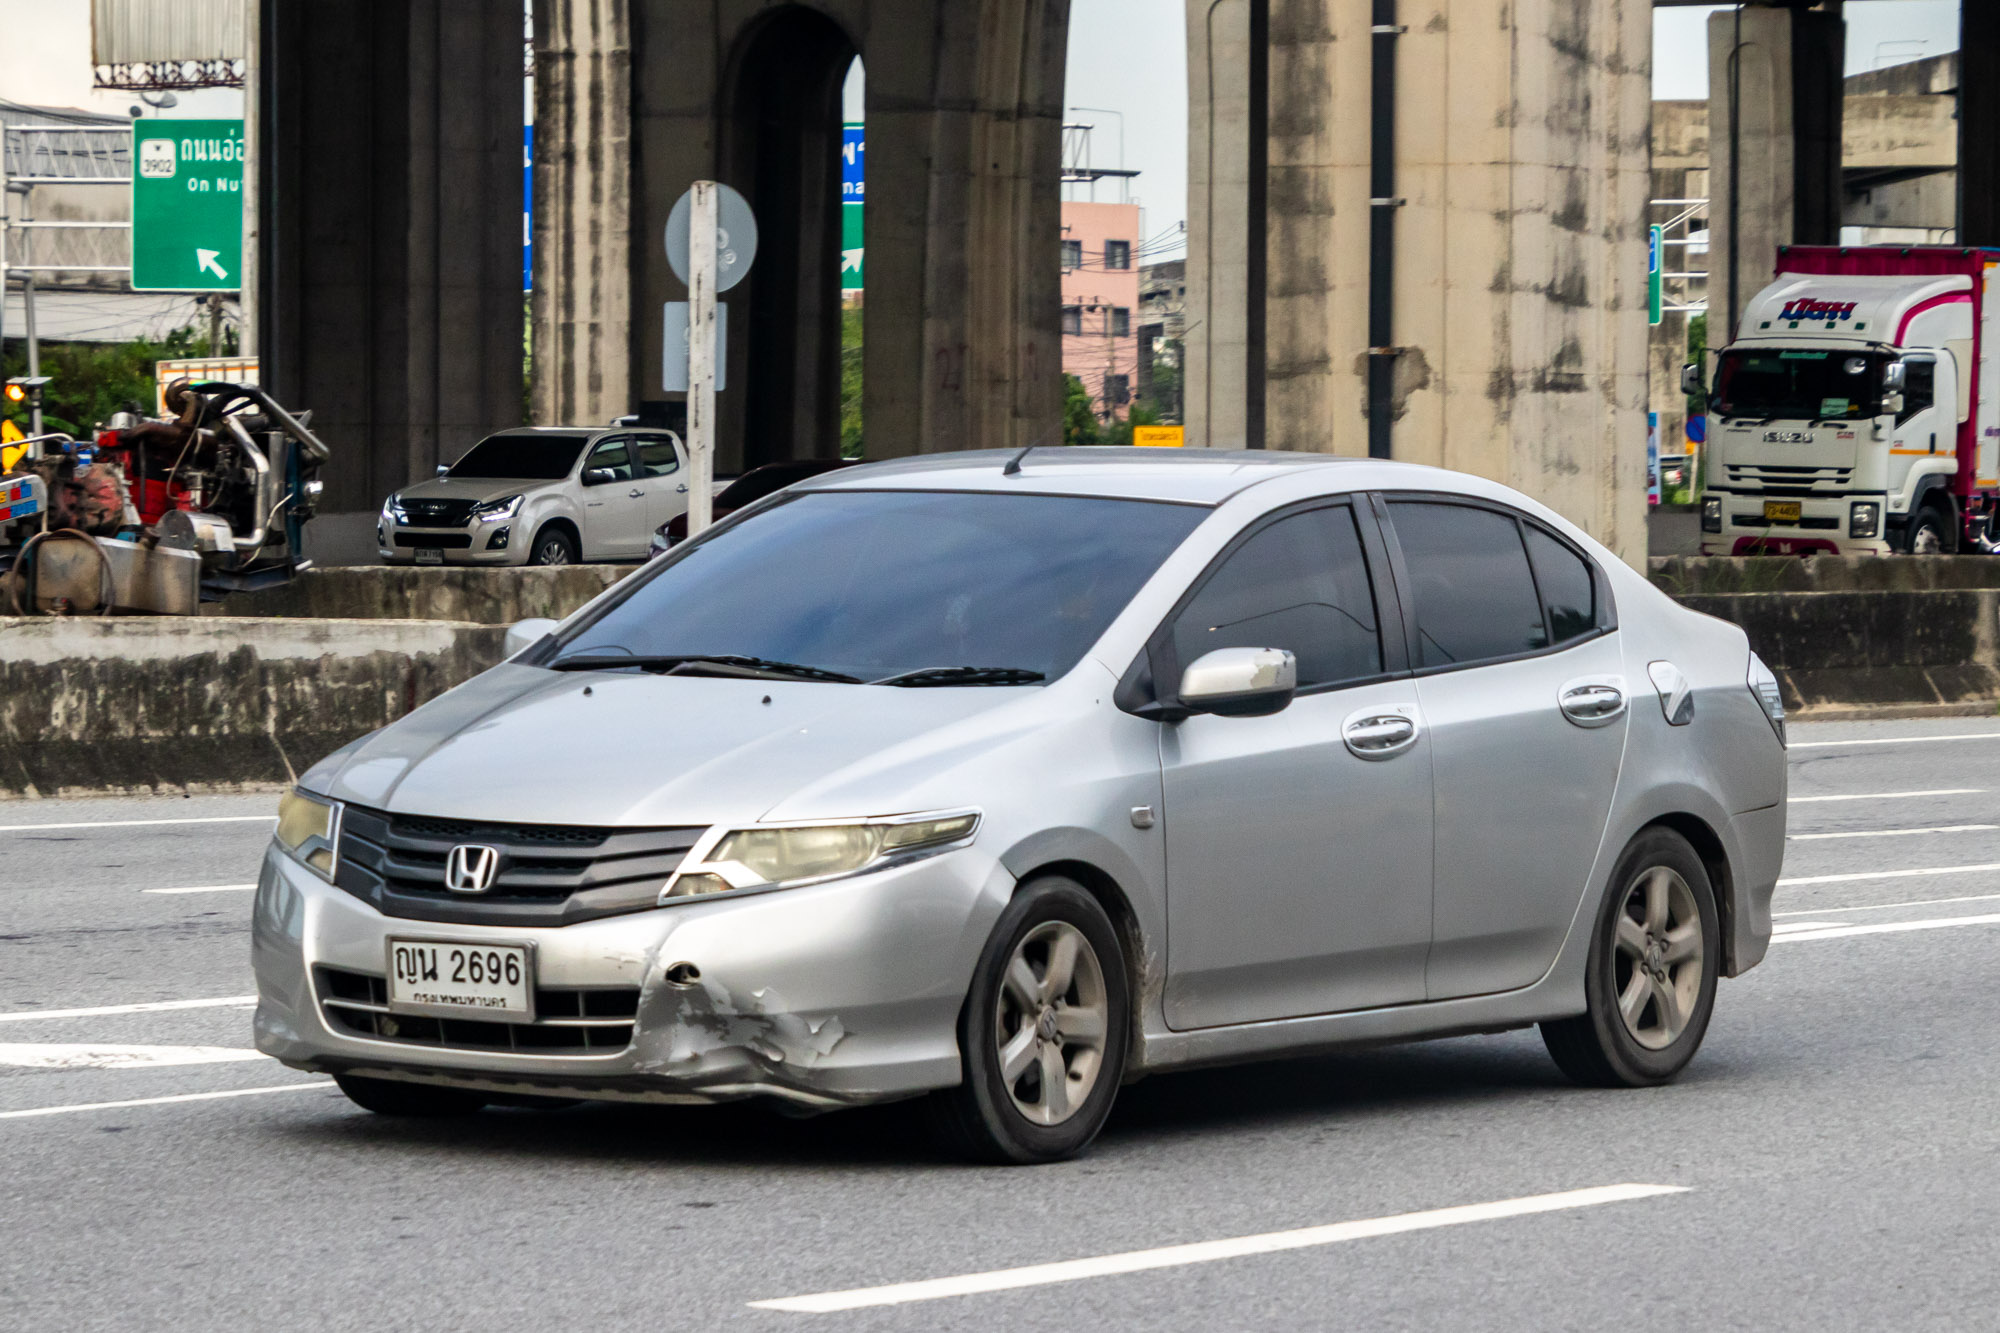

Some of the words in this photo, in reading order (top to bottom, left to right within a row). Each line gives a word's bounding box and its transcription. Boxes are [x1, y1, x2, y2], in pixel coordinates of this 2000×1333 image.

[144, 159, 172, 173] 3902
[187, 177, 210, 192] On
[216, 177, 244, 192] Nu
[1763, 431, 1815, 444] ISUZU
[396, 947, 438, 985] ญน
[449, 949, 520, 986] 2696
